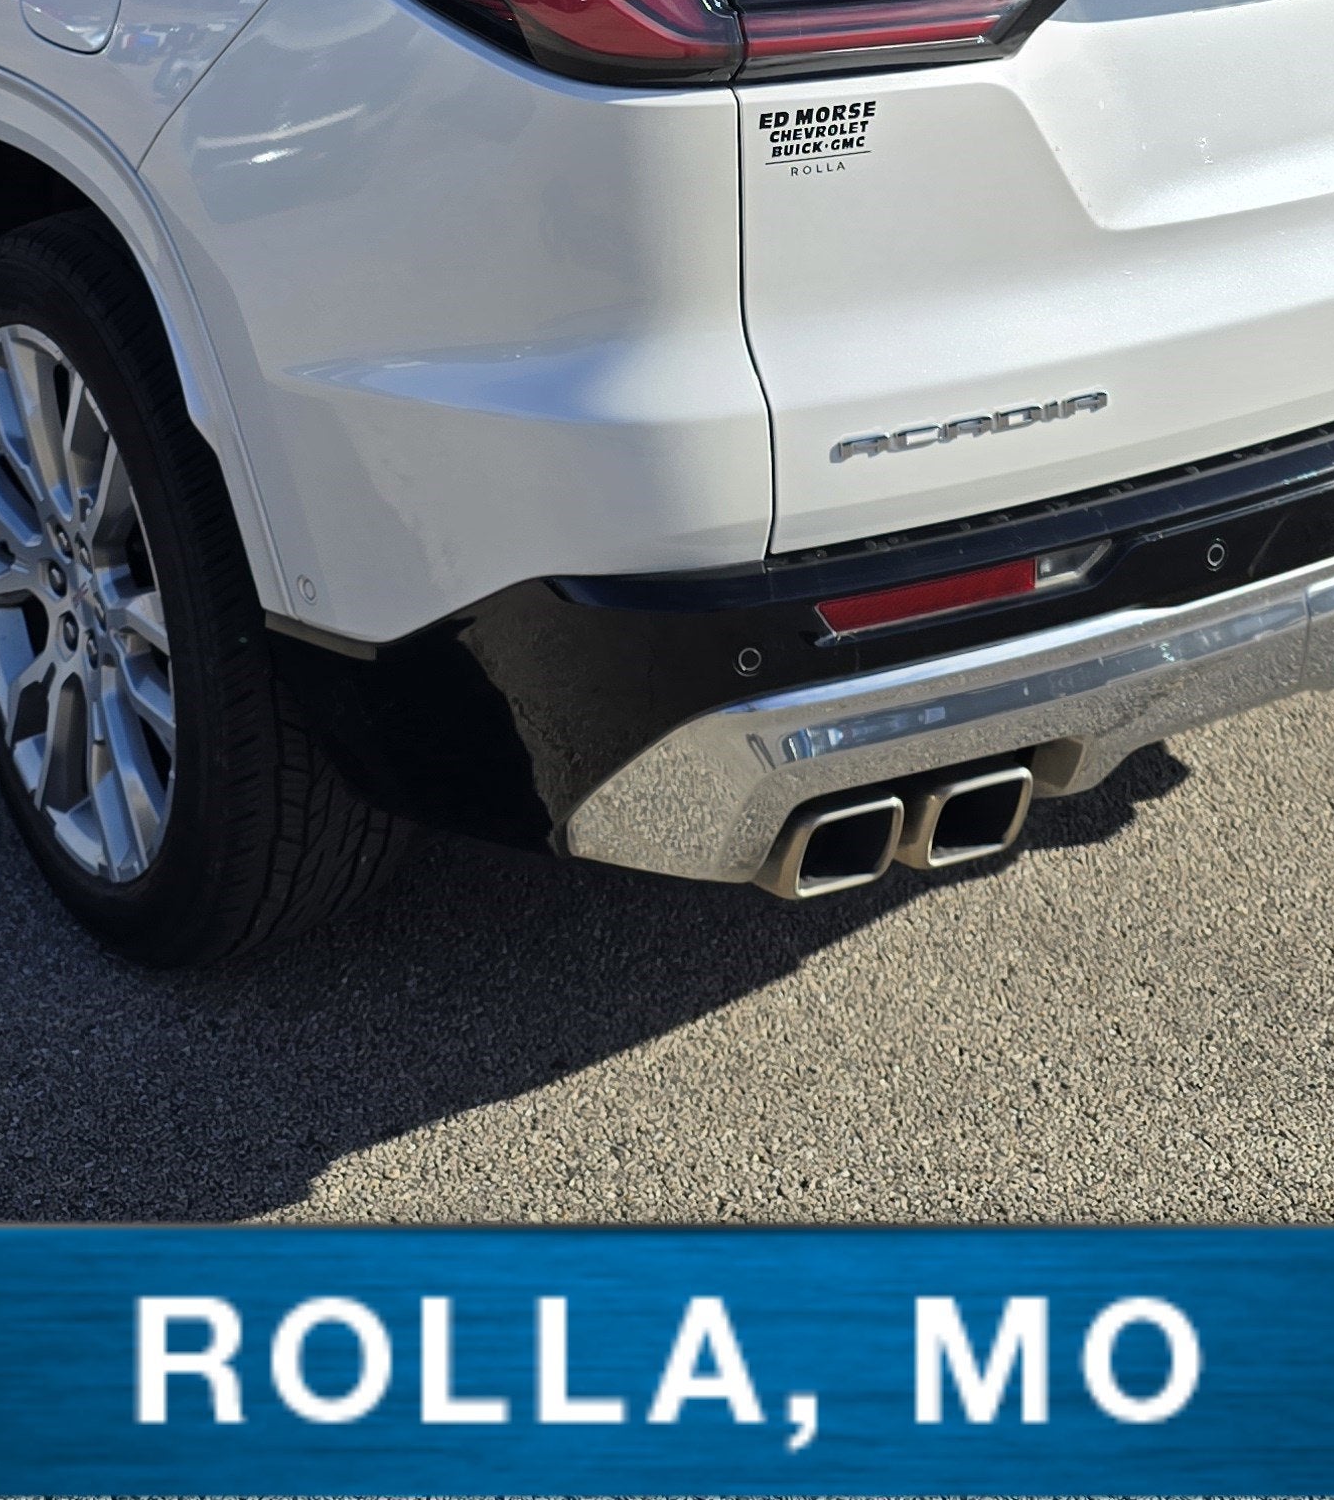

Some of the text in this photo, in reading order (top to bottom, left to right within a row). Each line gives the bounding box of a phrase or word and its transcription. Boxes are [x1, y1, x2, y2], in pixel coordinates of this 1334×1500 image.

[759, 100, 877, 130] ED MORSE
[769, 120, 869, 143] CHEVROLET
[790, 161, 846, 177] ROLLA
[831, 386, 1109, 463] ACADIA
